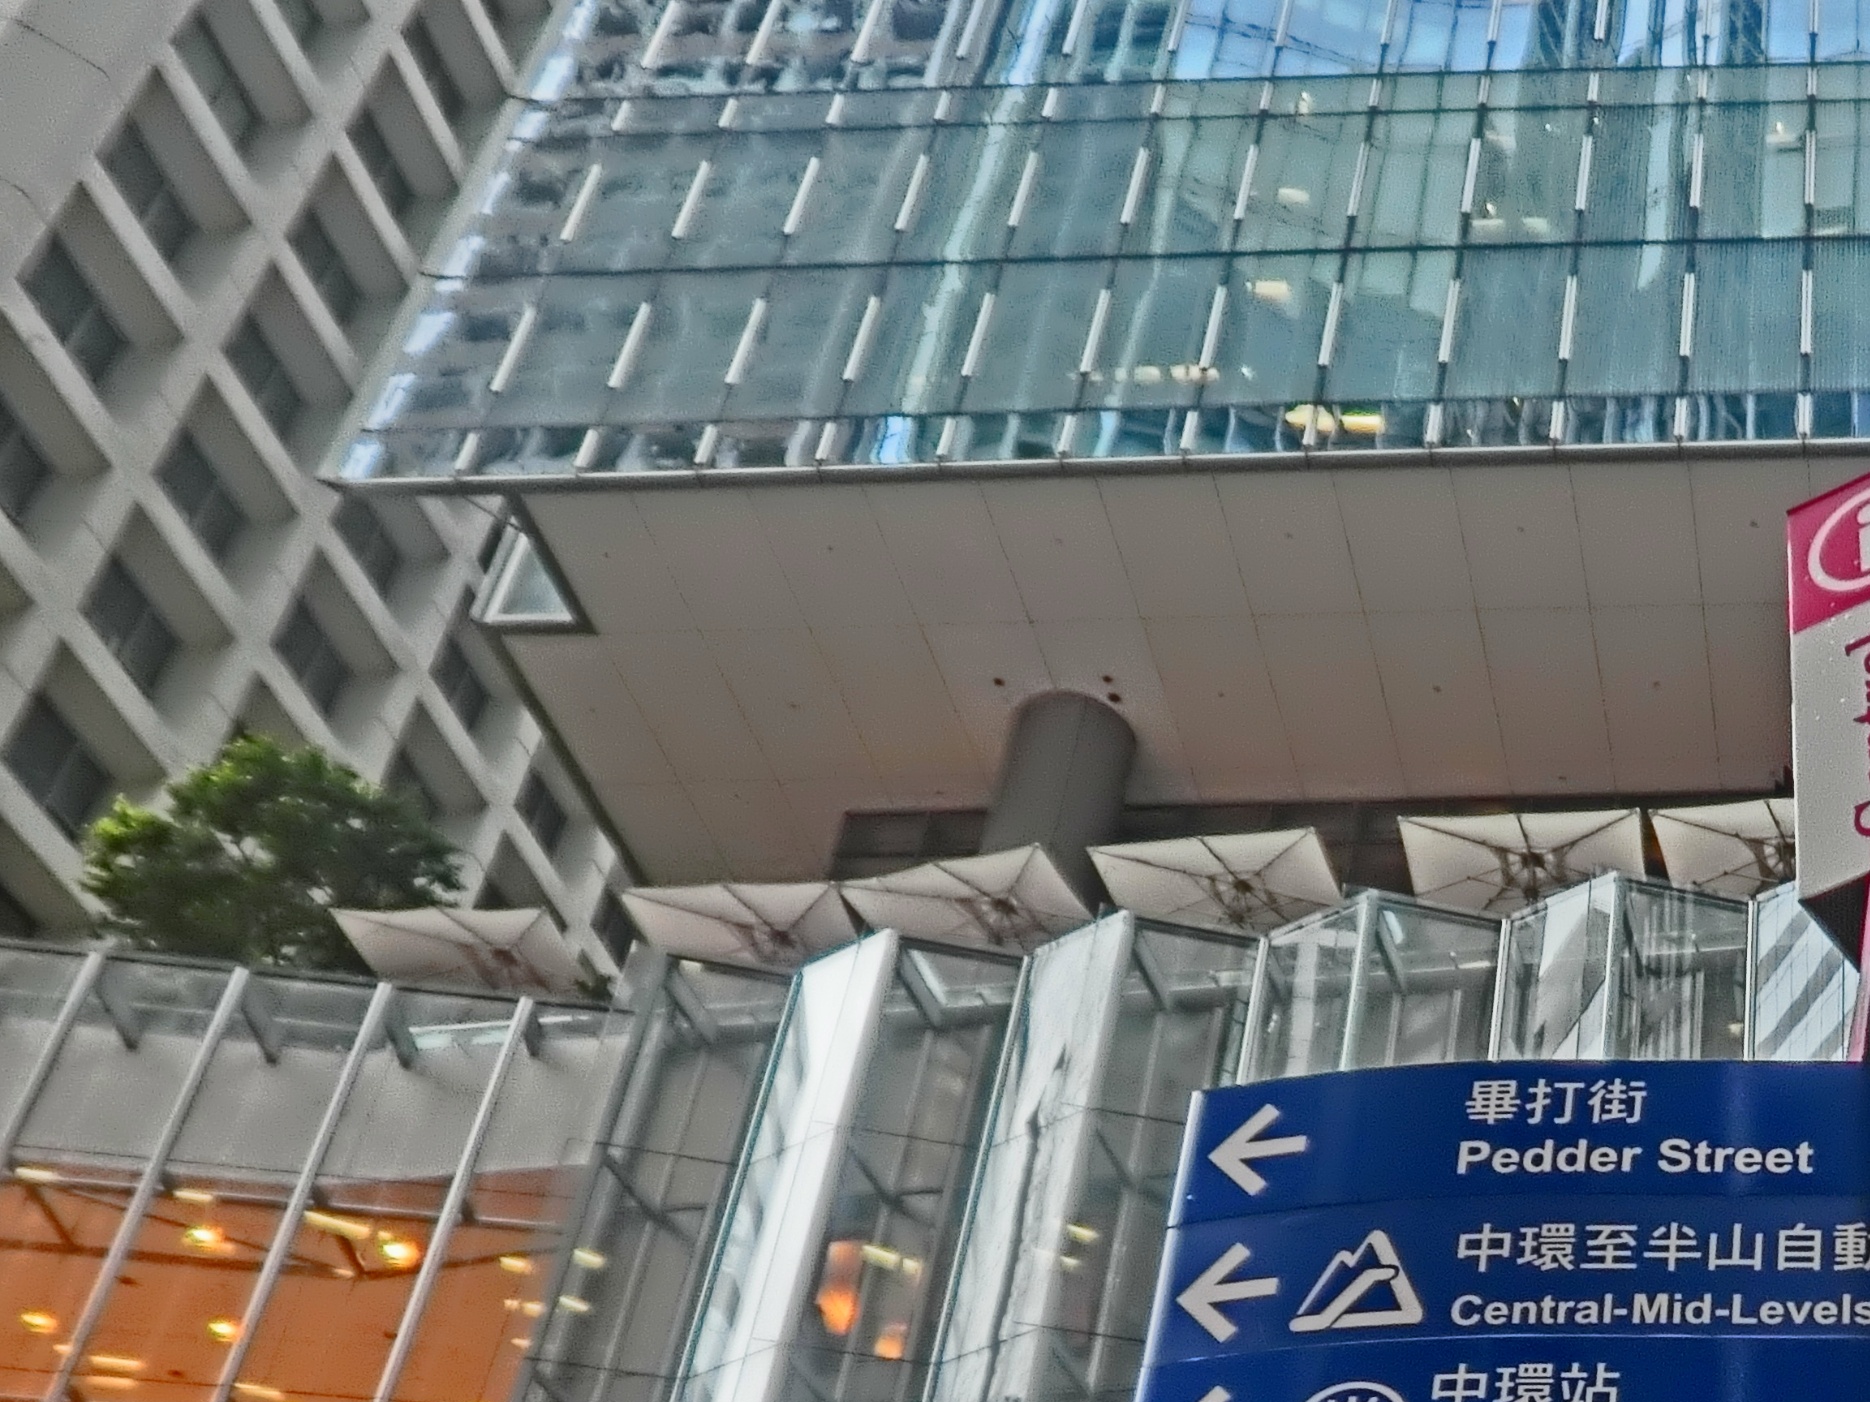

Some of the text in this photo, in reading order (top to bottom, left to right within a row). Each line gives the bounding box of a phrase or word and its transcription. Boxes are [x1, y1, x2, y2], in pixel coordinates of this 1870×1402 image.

[1465, 1078, 1647, 1124] 畢打街
[1457, 1138, 1814, 1174] Pedder Street
